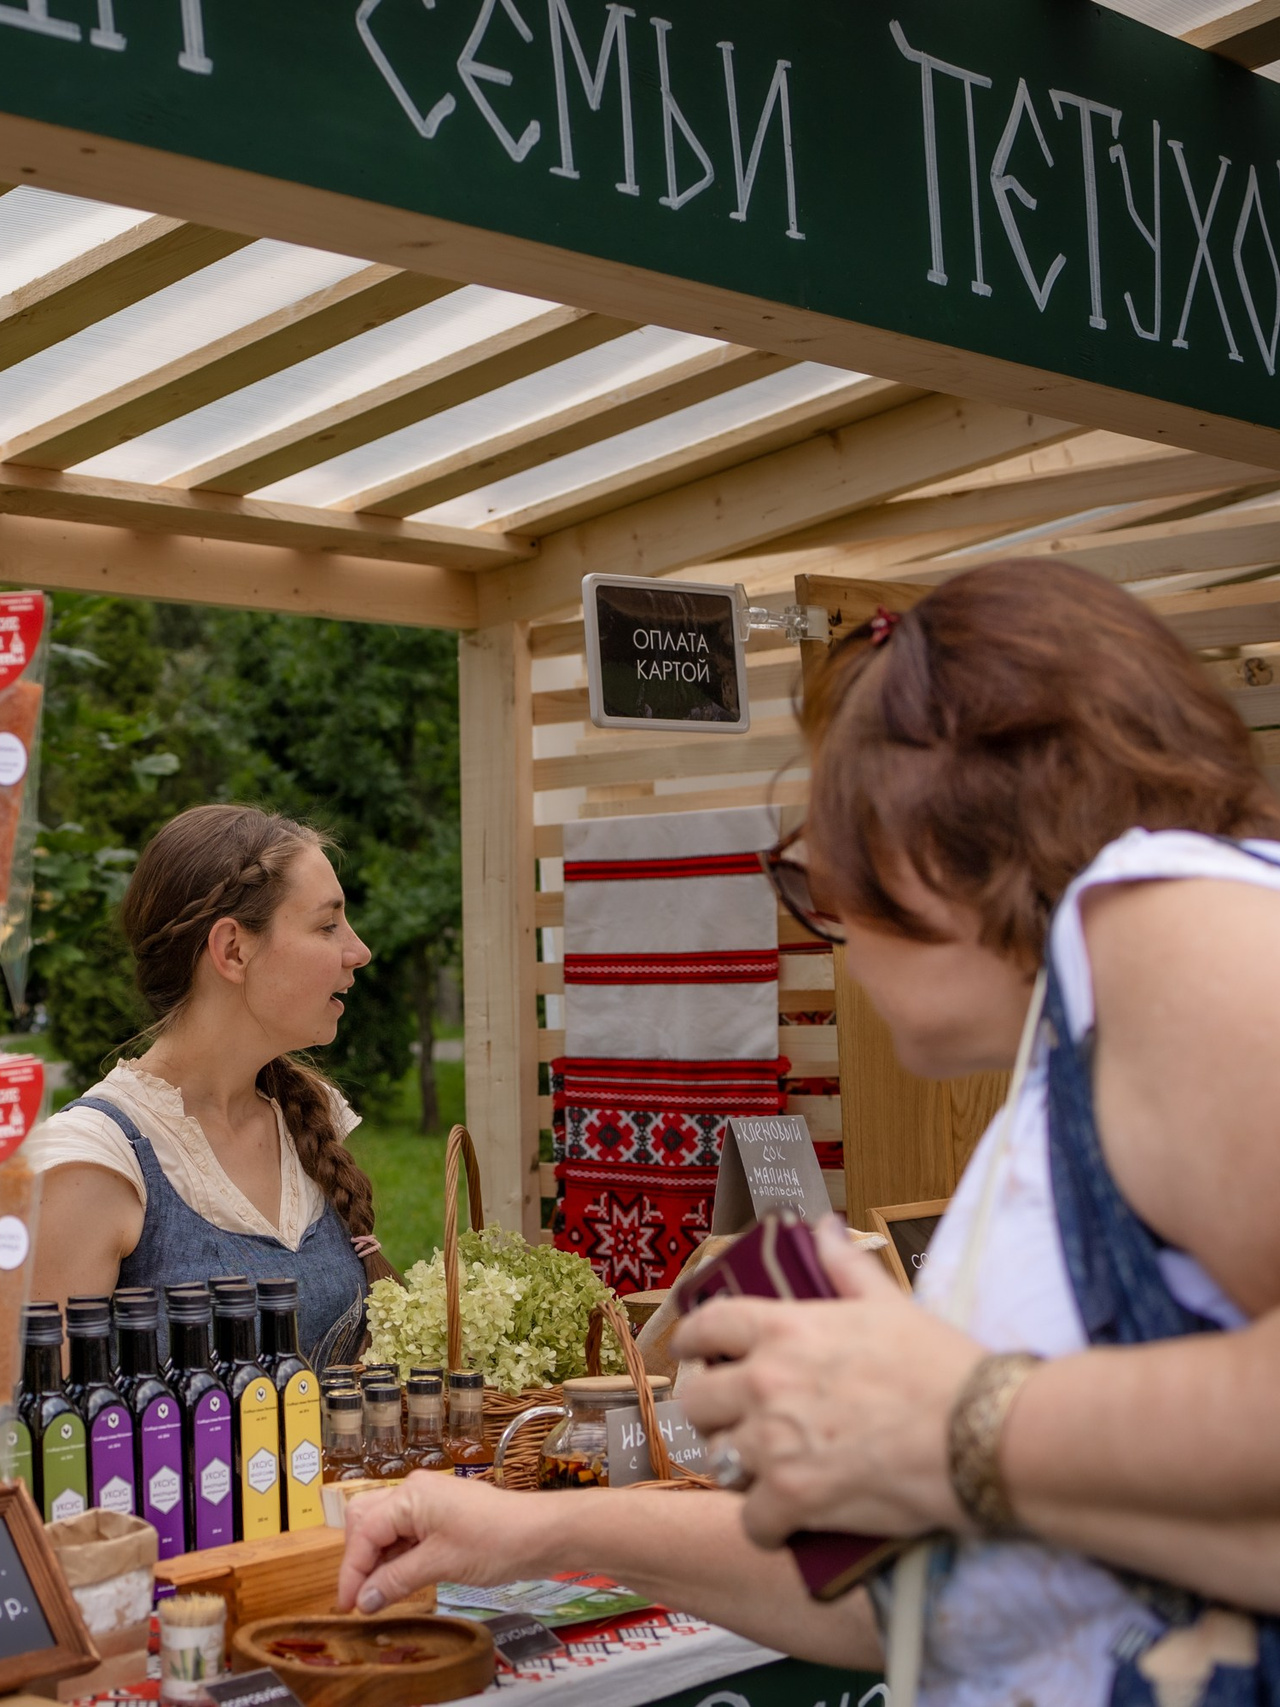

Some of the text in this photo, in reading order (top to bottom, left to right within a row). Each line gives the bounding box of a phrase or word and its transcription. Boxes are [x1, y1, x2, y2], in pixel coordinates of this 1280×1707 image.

[888, 19, 1280, 376] ПЕТУХО
[633, 628, 709, 653] ОПЛАТА
[637, 659, 710, 683] КАРТОЙ
[763, 1145, 785, 1162] СОК
[754, 1166, 800, 1186] МАЛИНА
